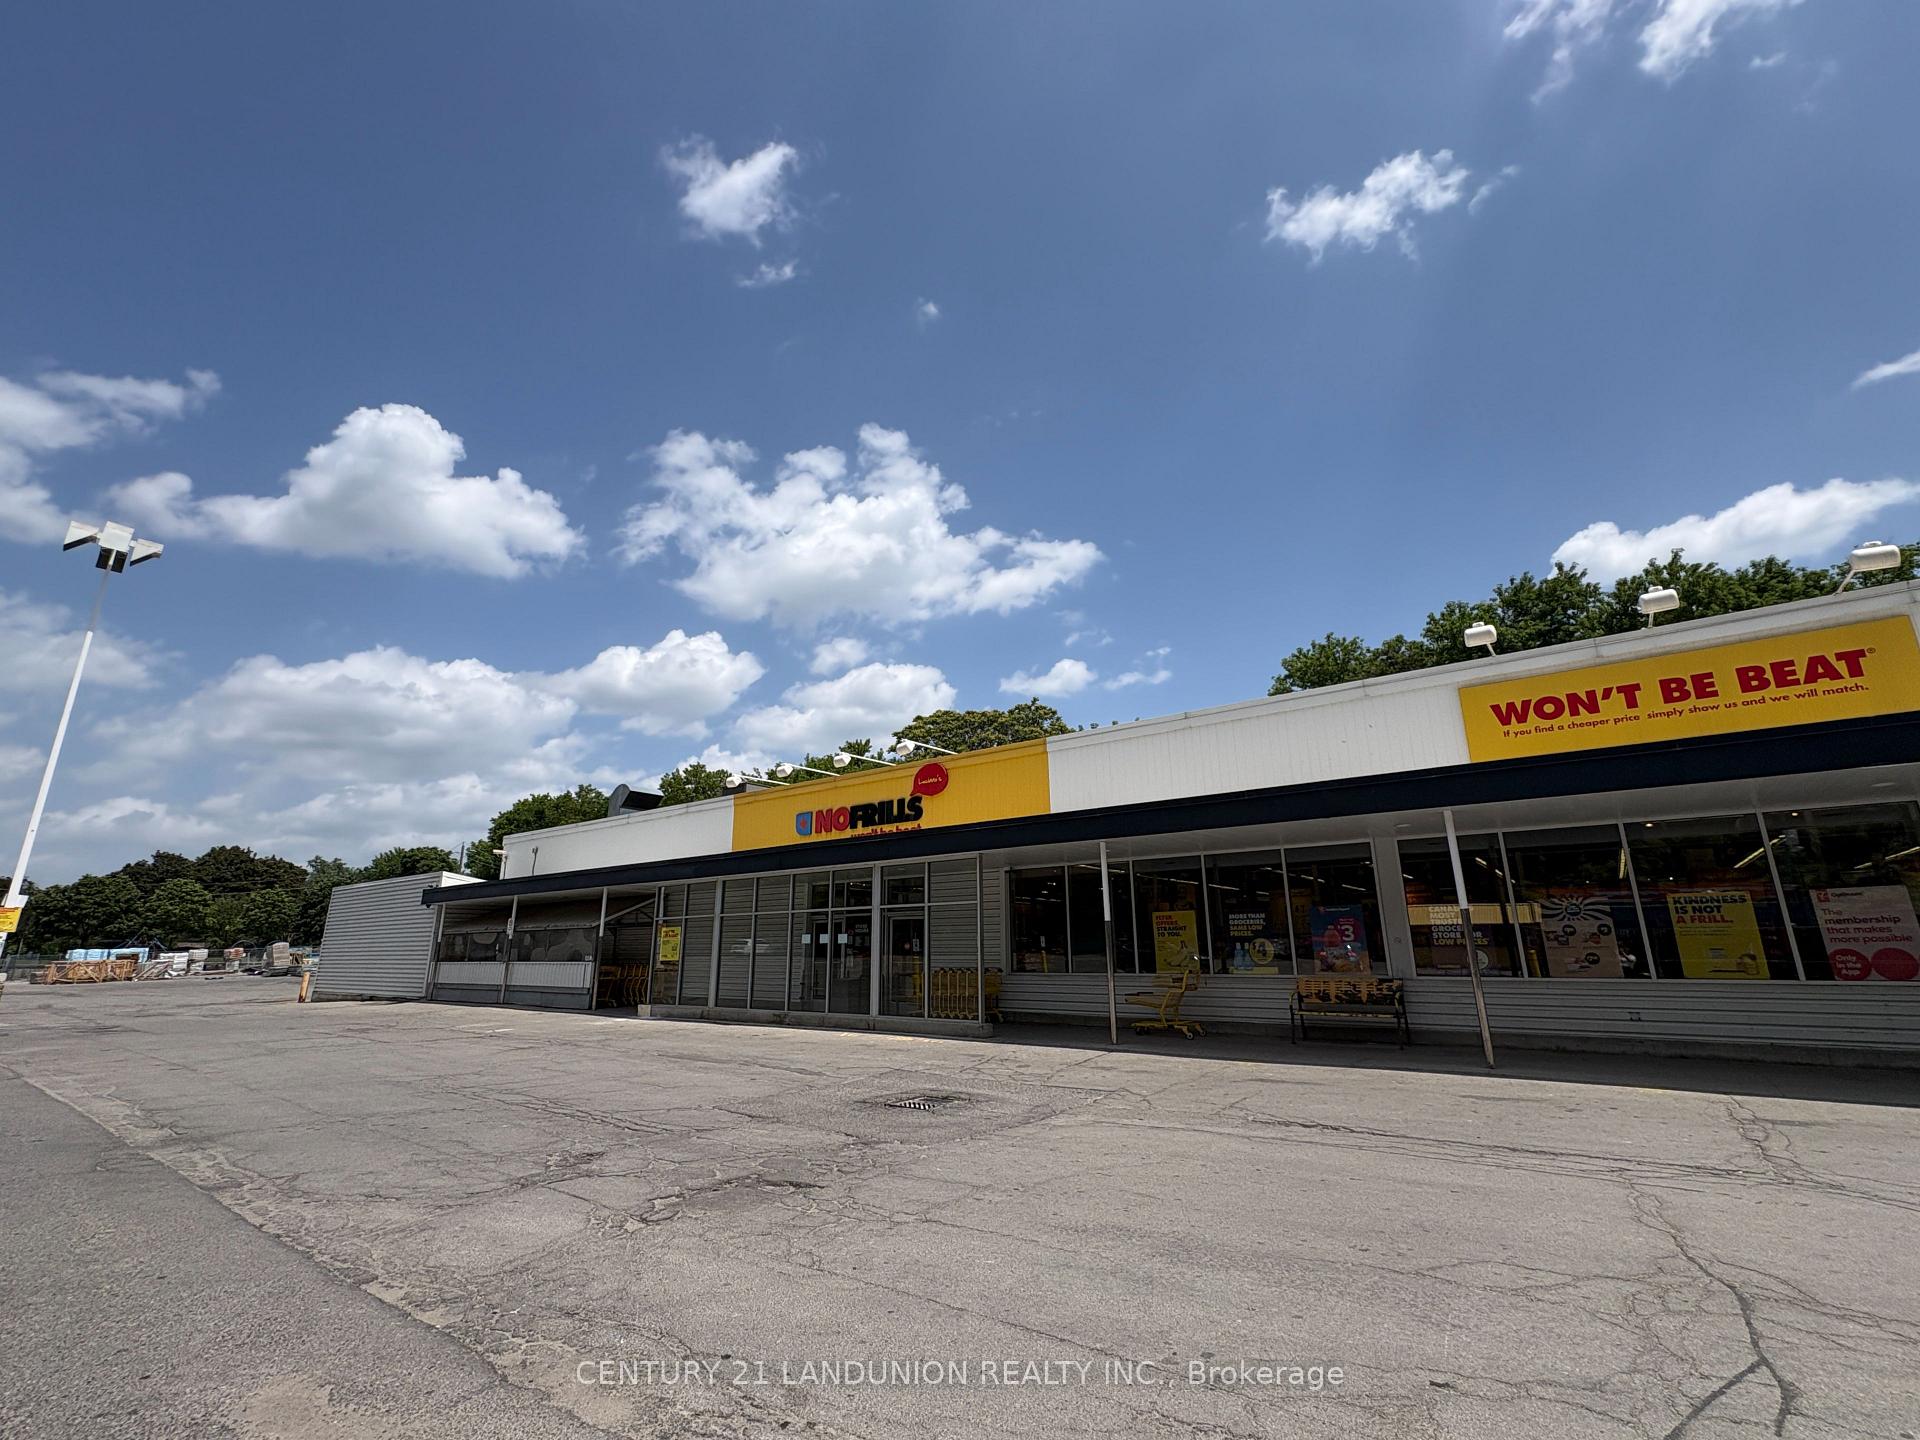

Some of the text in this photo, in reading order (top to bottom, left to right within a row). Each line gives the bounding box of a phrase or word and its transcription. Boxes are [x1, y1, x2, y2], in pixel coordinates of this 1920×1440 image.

[1490, 683, 1641, 726] WON'T
[1658, 672, 1719, 704] BE
[1503, 729, 1511, 738] If
[1513, 728, 1532, 738] you
[1535, 724, 1554, 734] find
[1568, 717, 1610, 729] cheaper
[1614, 714, 1640, 726] price
[1647, 707, 1684, 720] simply
[1688, 703, 1721, 714] show
[1742, 696, 1766, 707] and
[1769, 695, 1790, 703] we
[1794, 688, 1818, 699] will
[1822, 683, 1869, 696] match.
[1672, 895, 1747, 905] KINDNESS
[1674, 905, 1722, 915] IS NOT
[1822, 908, 1842, 916] The
[1676, 914, 1734, 924] A FRILL.
[1825, 915, 1901, 925] membership
[1827, 925, 1893, 934] that makes
[1863, 933, 1913, 945] possible
